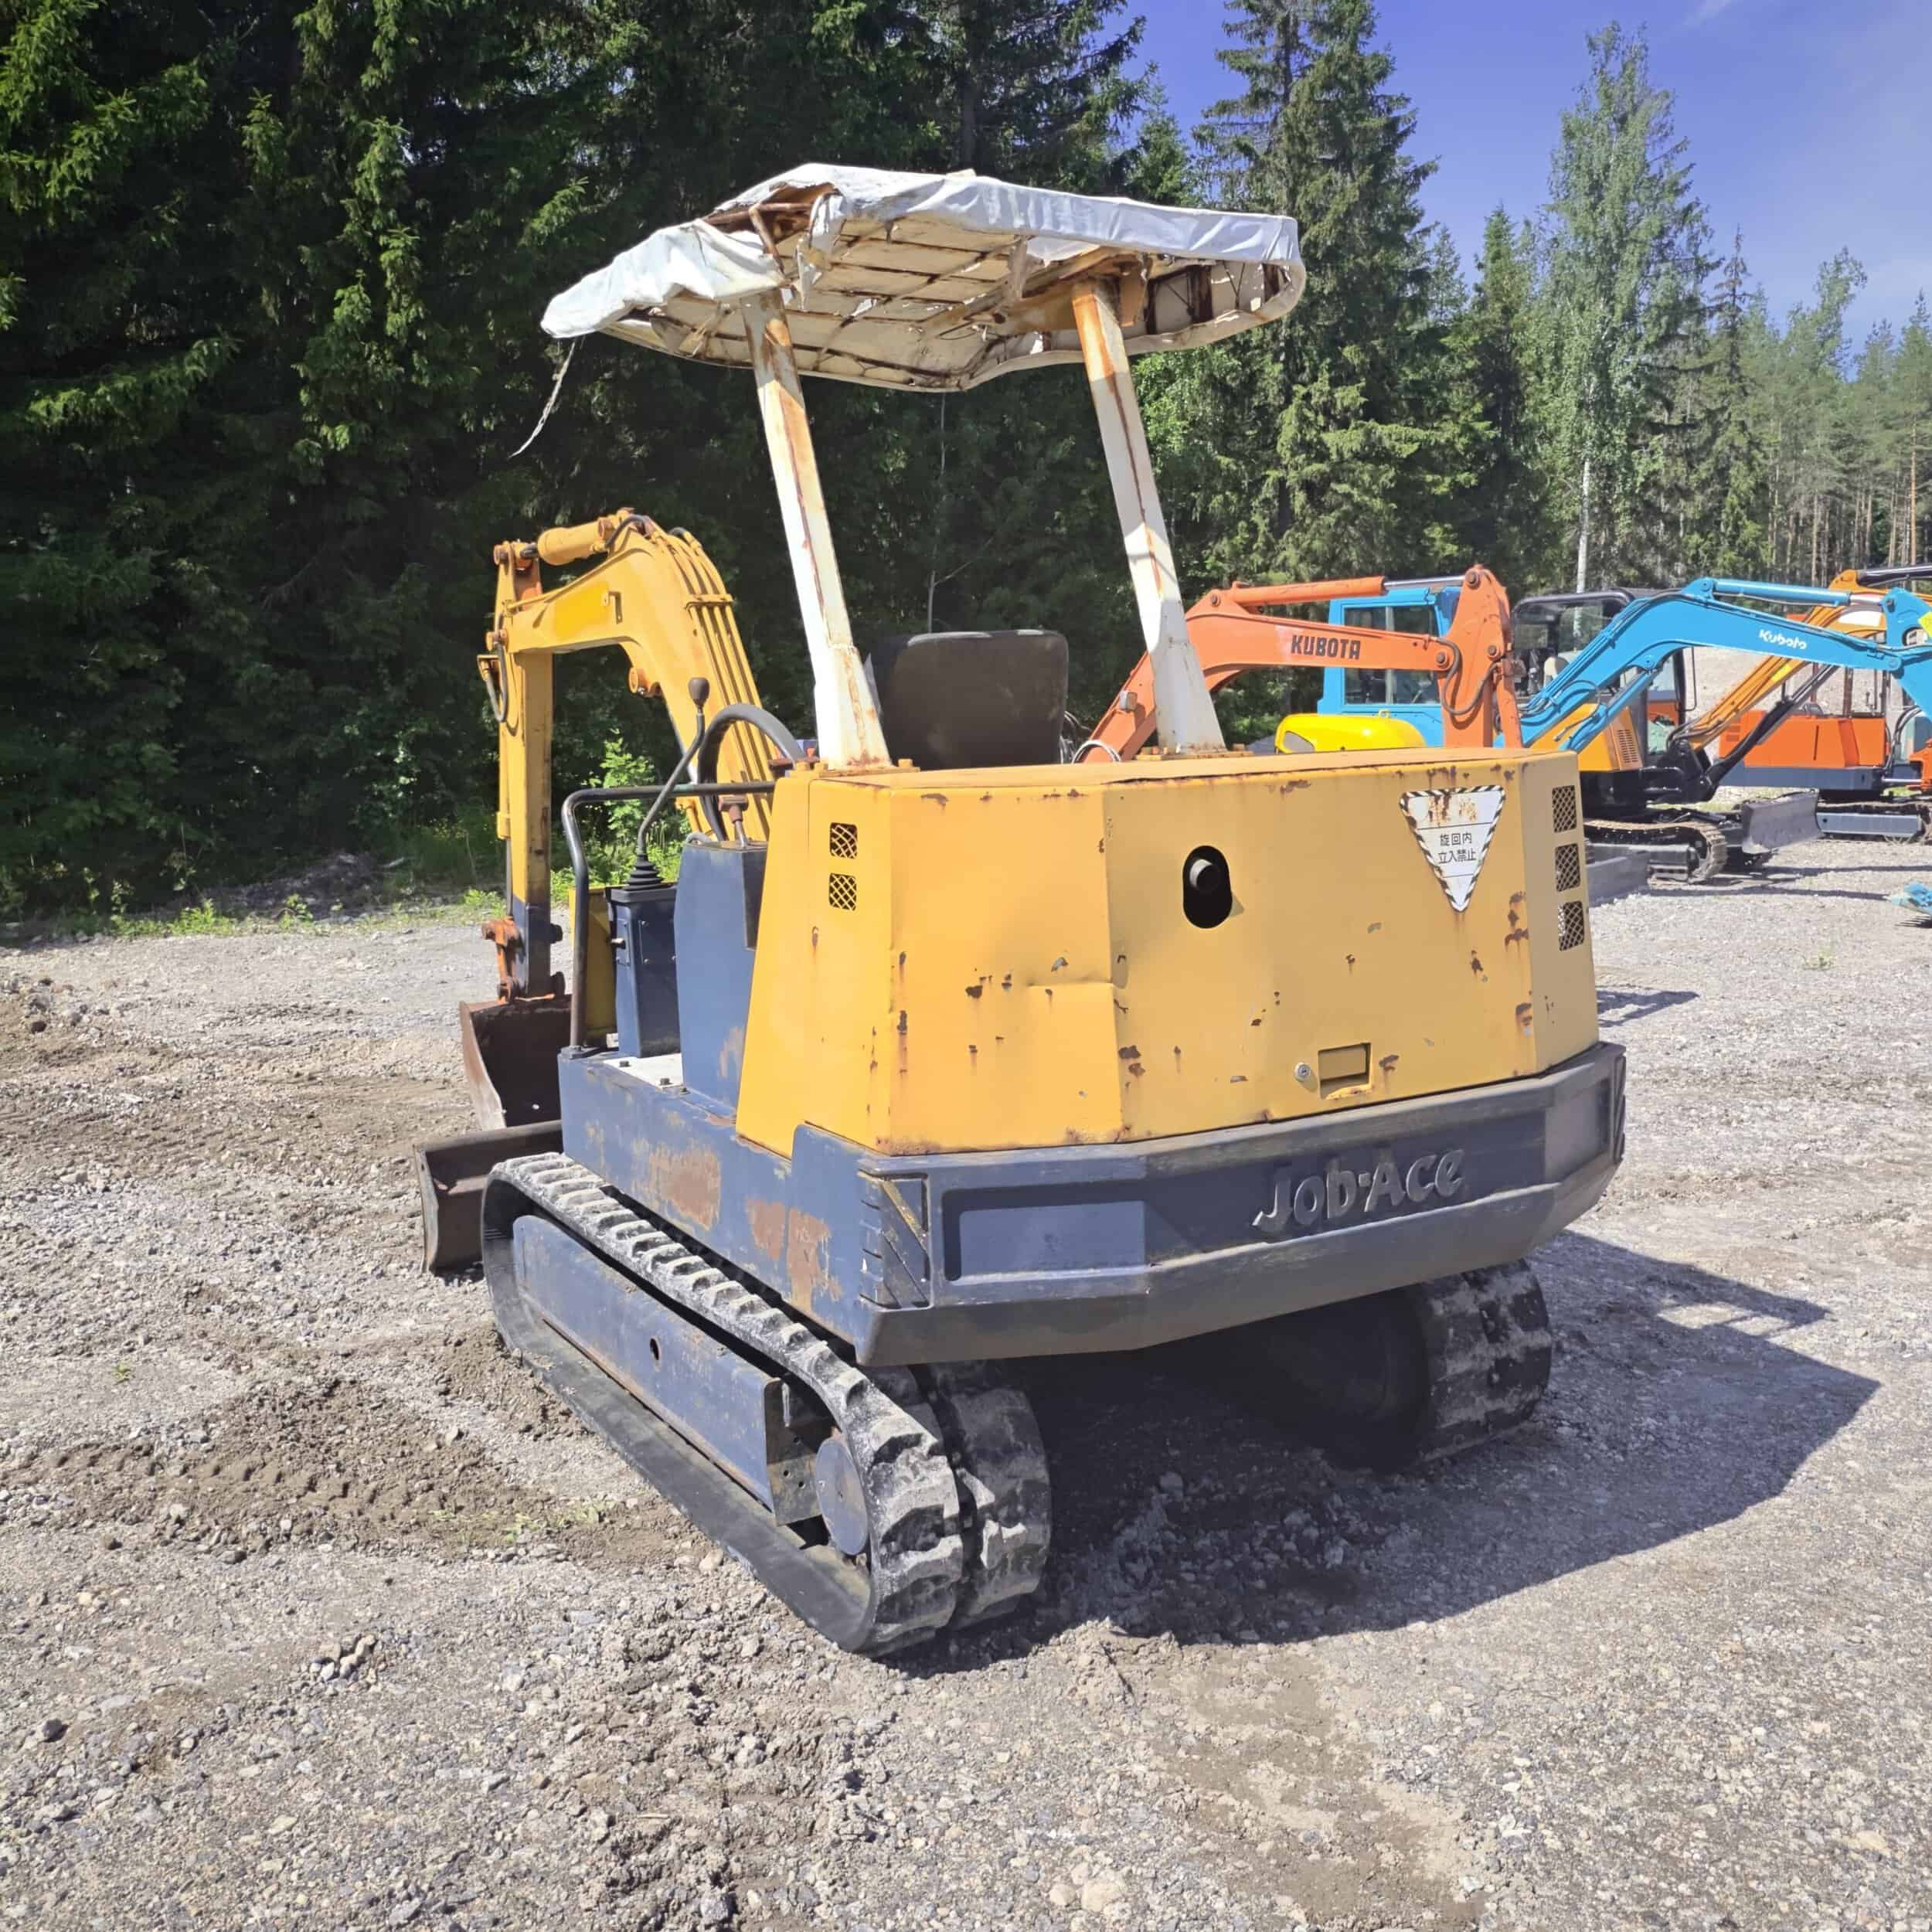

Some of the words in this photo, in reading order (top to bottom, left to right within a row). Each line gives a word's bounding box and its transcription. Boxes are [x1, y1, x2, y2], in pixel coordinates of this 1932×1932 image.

[1291, 634, 1361, 660] KUBOTA
[1759, 629, 1807, 649] Kubota
[1440, 832, 1472, 847] 旋回内
[1438, 849, 1477, 864] 立入禁止
